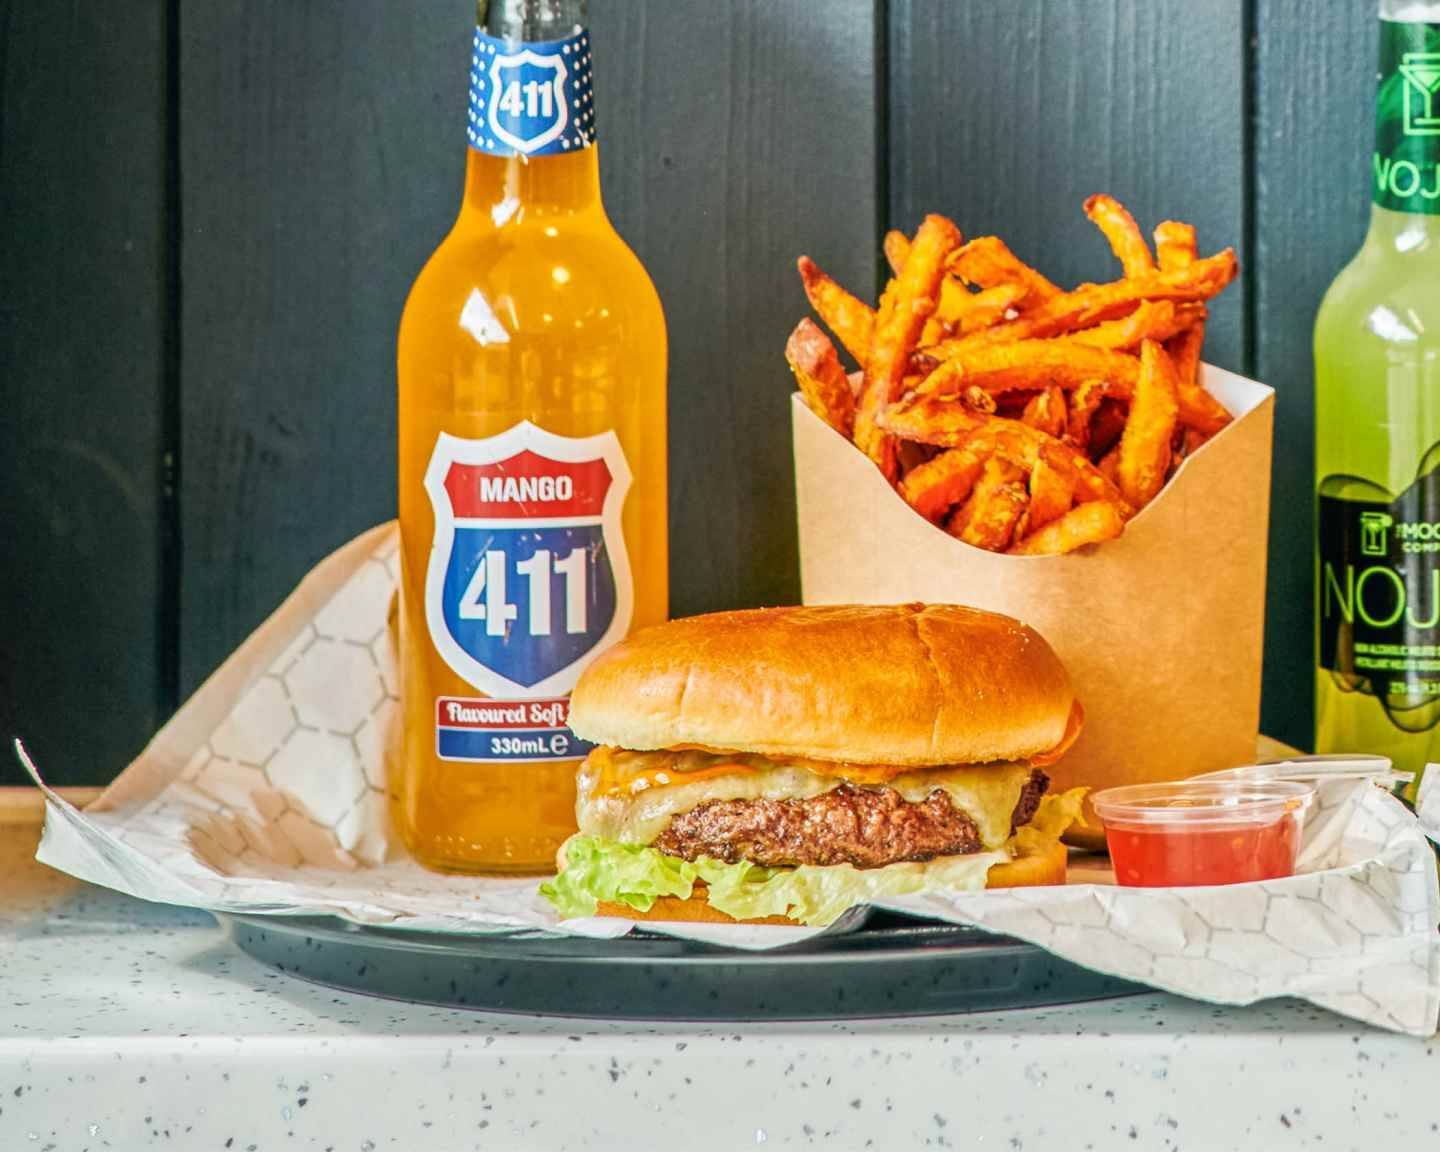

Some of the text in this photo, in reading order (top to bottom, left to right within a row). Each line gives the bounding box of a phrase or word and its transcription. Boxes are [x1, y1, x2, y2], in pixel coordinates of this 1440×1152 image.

[500, 80, 553, 117] 411
[480, 475, 573, 503] MANGO
[458, 549, 588, 636] 411
[446, 702, 564, 727] Flavoured Soft
